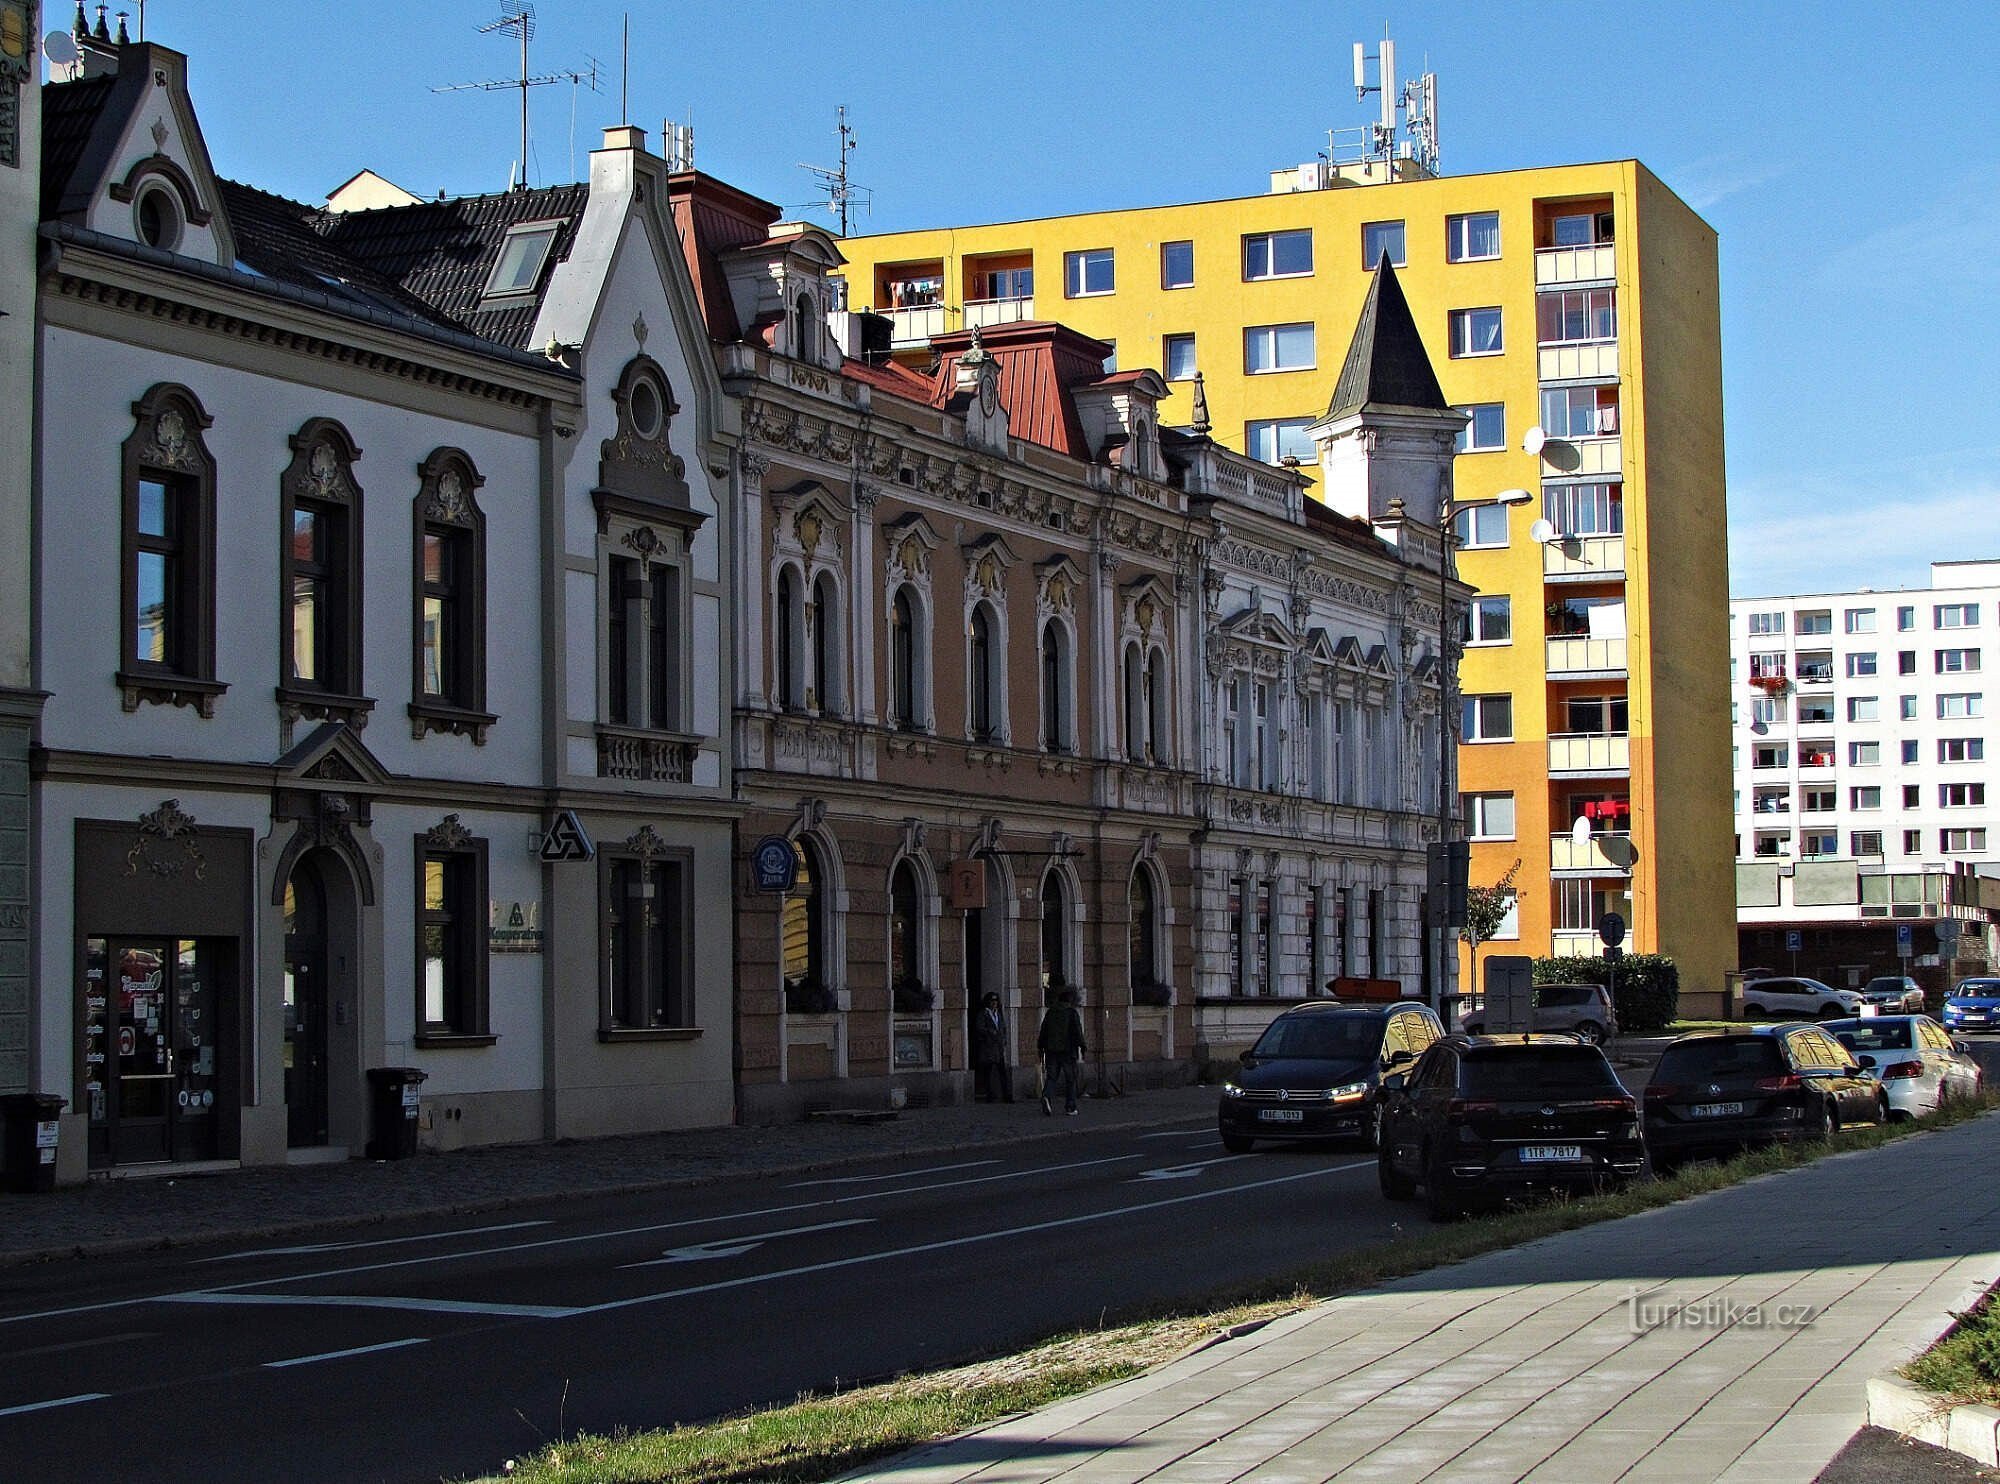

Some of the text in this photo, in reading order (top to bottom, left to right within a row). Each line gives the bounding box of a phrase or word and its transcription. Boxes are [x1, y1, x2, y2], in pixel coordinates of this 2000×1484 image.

[1900, 926, 1908, 937] P
[1789, 933, 1798, 944] P
[1527, 1147, 1576, 1157] 1TR 7817
